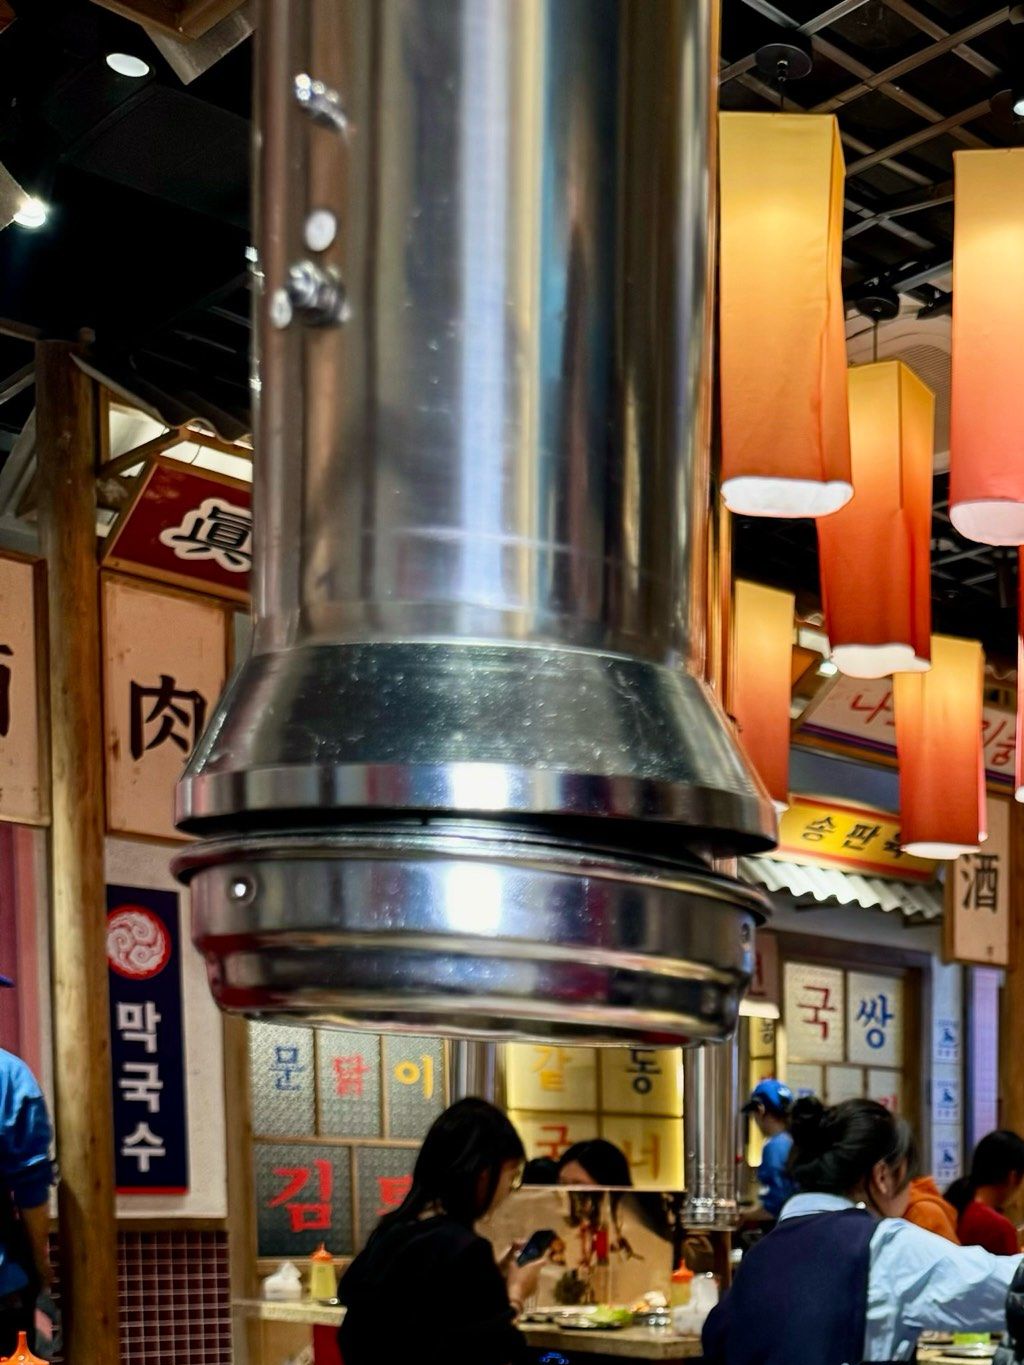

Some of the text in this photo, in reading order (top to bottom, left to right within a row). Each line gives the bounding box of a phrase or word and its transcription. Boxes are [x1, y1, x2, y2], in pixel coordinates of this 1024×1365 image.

[130, 674, 207, 761] 肉
[960, 853, 1000, 912] 酒
[796, 985, 837, 1041] 국
[116, 1001, 167, 1174] 막국수
[269, 1044, 306, 1092] 문
[394, 1055, 435, 1100] 이
[267, 1158, 334, 1233] 김
